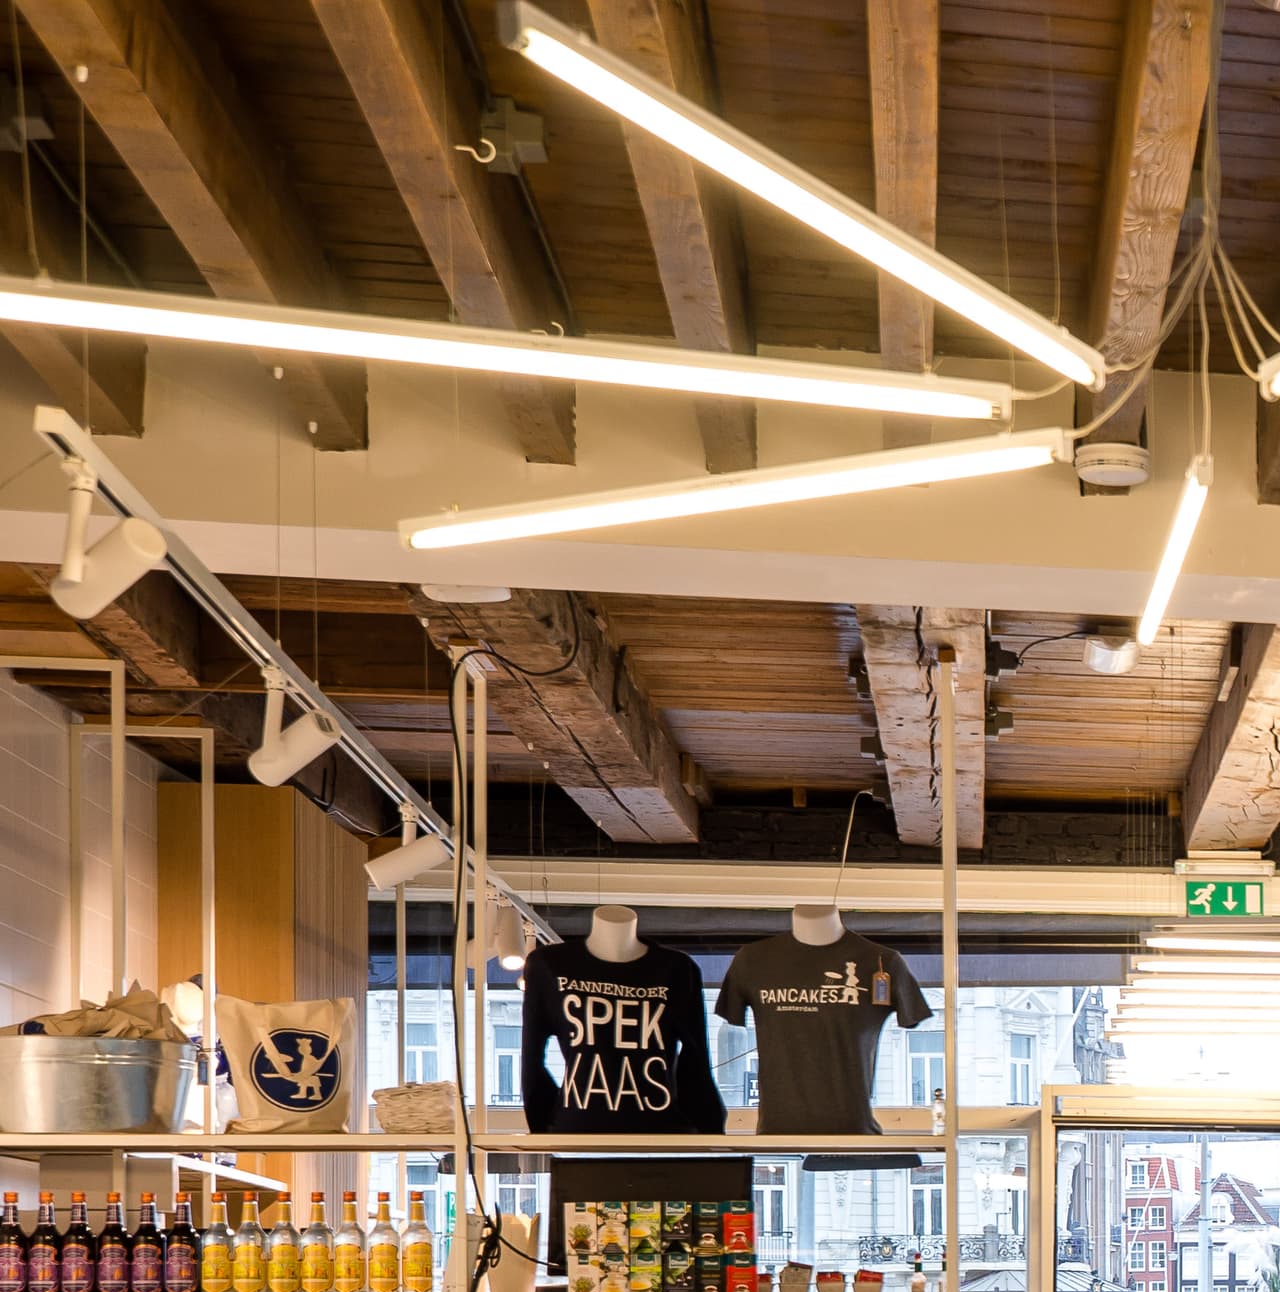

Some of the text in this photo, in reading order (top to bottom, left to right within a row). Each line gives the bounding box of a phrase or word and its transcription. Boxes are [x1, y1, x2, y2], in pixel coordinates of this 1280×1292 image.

[557, 976, 670, 1001] PANNENKOEK
[760, 987, 839, 1004] PANCAKES
[563, 993, 667, 1051] SPEK
[563, 1052, 671, 1112] KAAS
